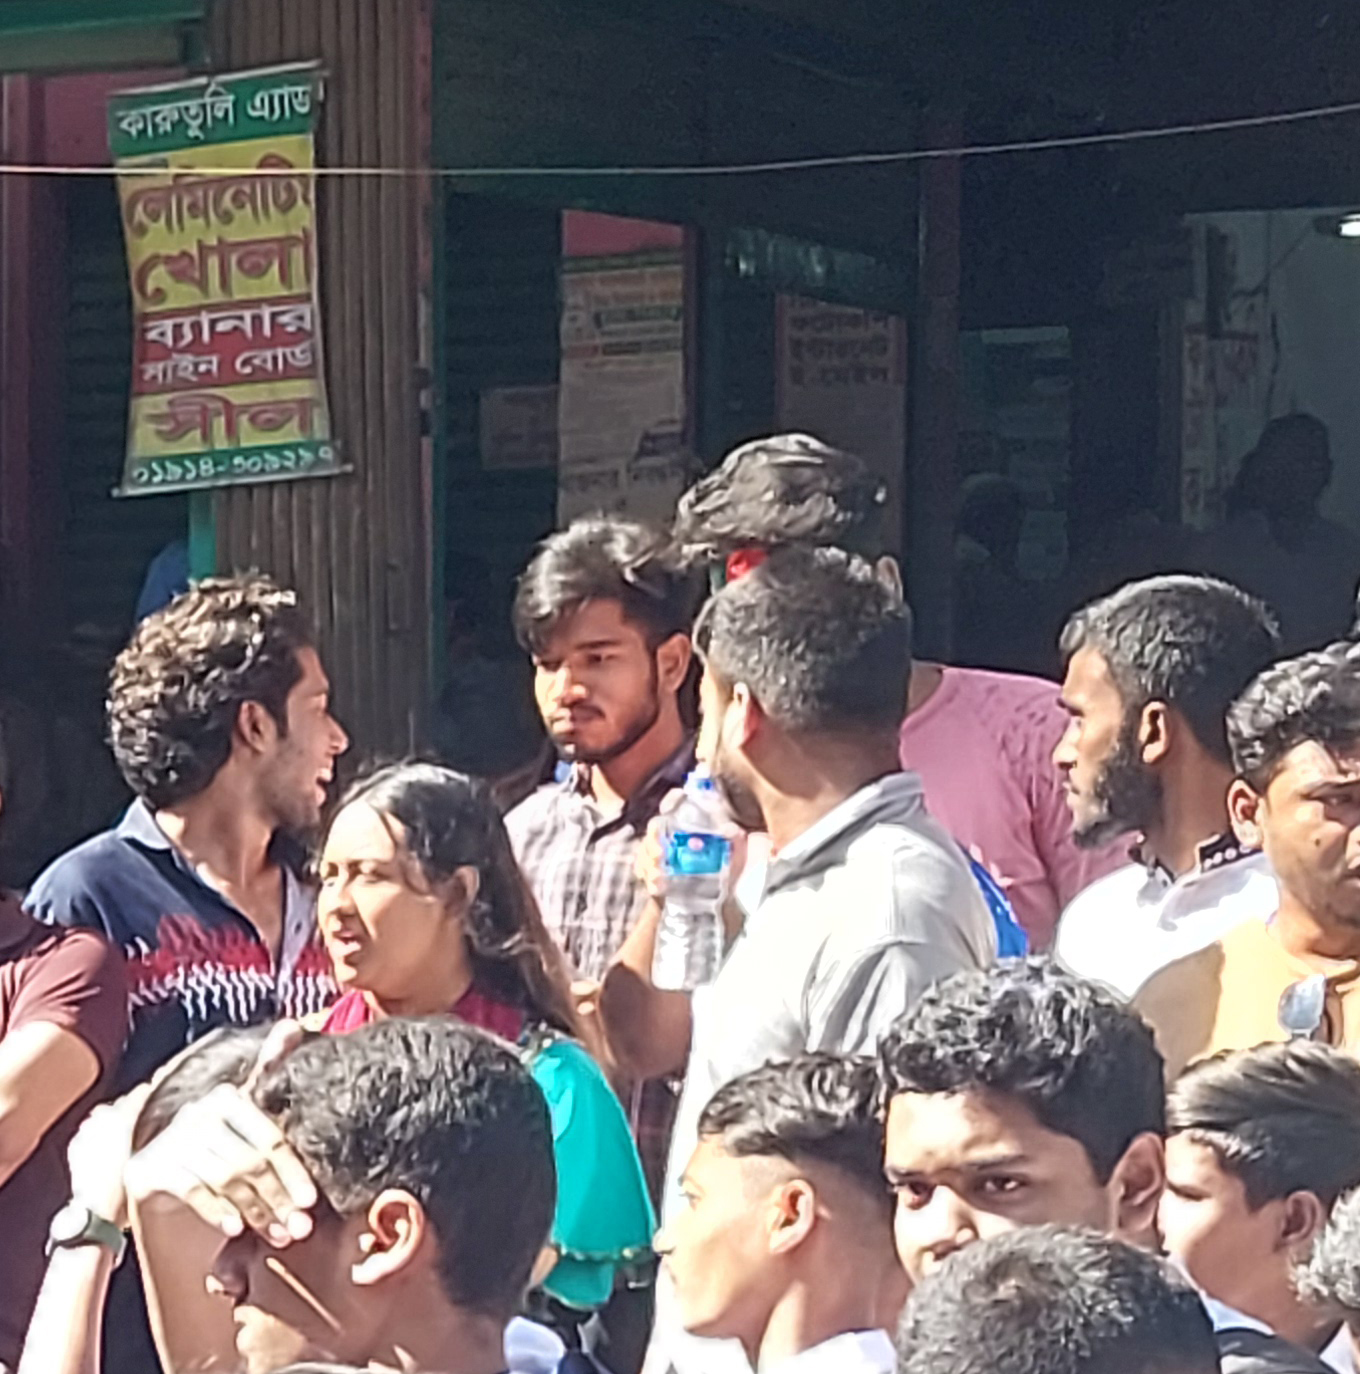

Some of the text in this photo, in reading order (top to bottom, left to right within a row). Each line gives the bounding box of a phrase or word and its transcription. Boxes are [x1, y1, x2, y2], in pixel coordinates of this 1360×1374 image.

[135, 227, 312, 303] খোলা
[143, 302, 312, 348] ব্যানার
[141, 353, 220, 384] সাইন
[145, 393, 314, 448] সীল
